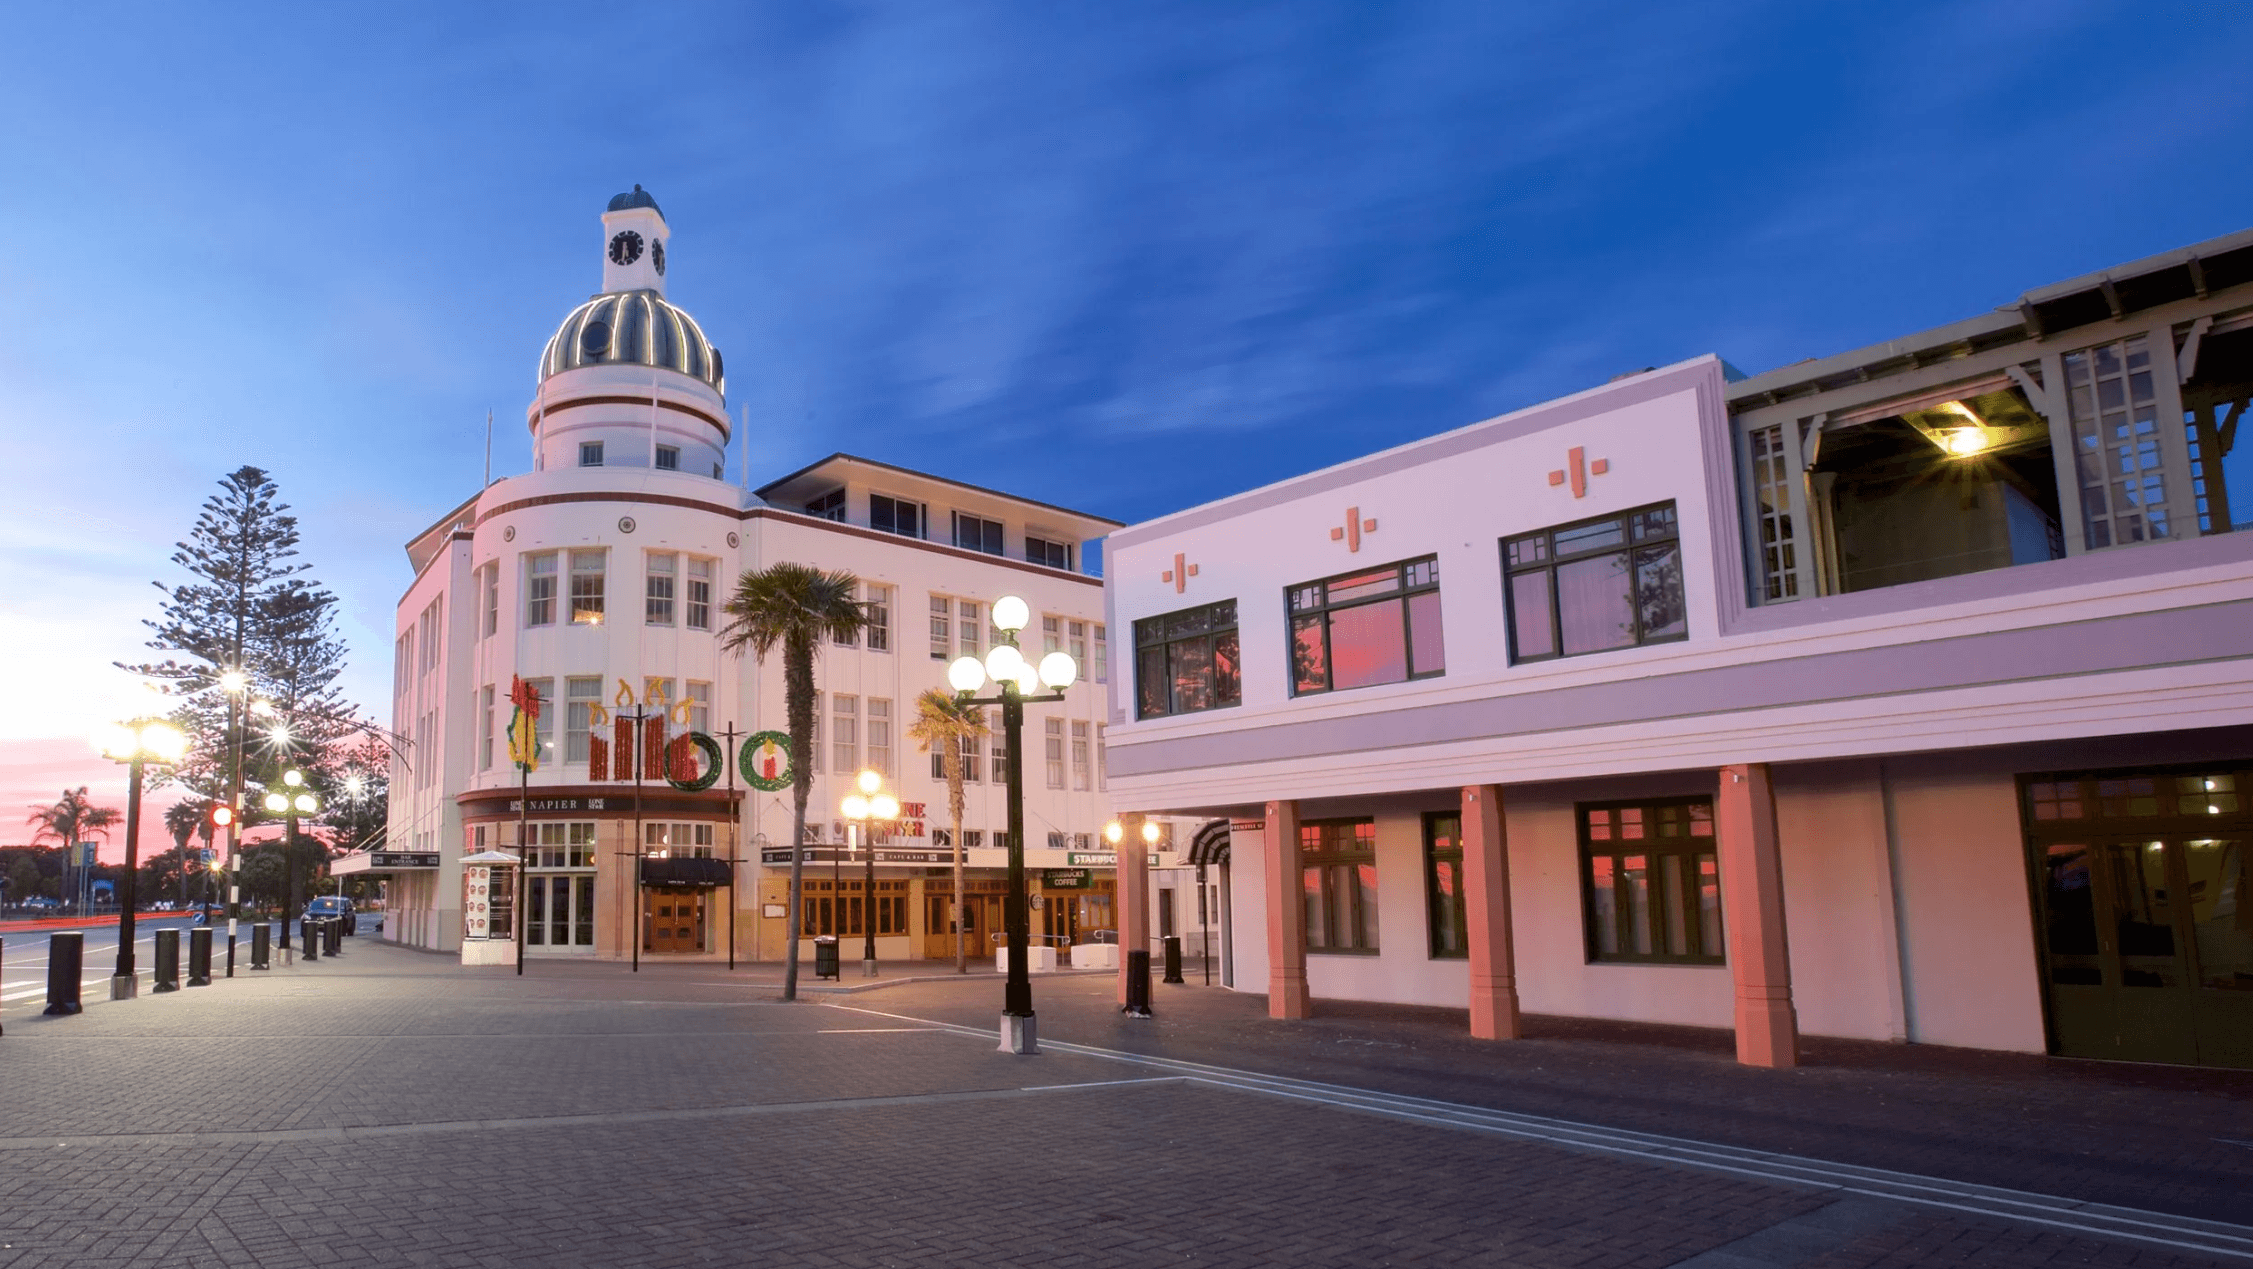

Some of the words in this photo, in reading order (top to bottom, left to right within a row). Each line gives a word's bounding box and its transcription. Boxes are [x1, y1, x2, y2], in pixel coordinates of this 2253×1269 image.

[530, 800, 577, 810] NAPIER
[1073, 854, 1117, 864] STARBUC
[1047, 870, 1085, 878] STARBUCKS
